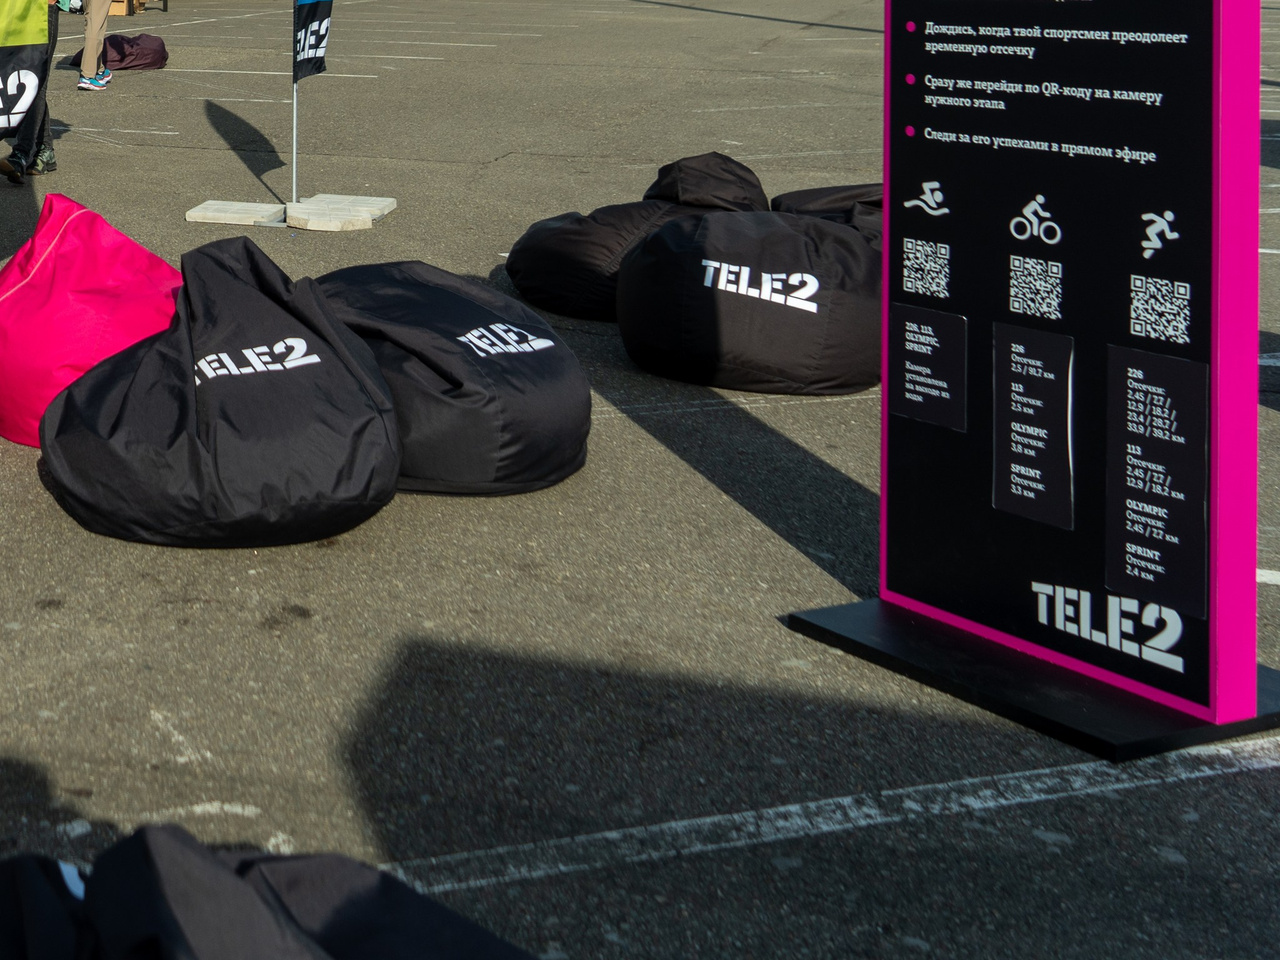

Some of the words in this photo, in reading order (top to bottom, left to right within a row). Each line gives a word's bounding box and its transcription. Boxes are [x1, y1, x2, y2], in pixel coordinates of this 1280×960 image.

[925, 22, 976, 37] Дождись,
[979, 26, 1011, 38] когда
[1013, 26, 1041, 37] твой
[1043, 28, 1109, 41] спортсмен
[1112, 31, 1188, 45] преодолеет
[925, 42, 988, 56] временную
[990, 45, 1035, 59] отсечку
[925, 75, 954, 90] Сразу
[956, 79, 972, 89] же
[974, 79, 1023, 93] перейди
[1025, 84, 1039, 93] по
[1041, 82, 1092, 100] QR-коду
[1094, 88, 1111, 98] на
[1113, 90, 1163, 106] камеру
[925, 94, 971, 107] нужного
[973, 99, 1005, 110] этапа
[924, 128, 956, 141] Следи
[959, 133, 970, 143] за
[972, 135, 990, 145] его
[992, 136, 1049, 151] успехами
[1051, 143, 1059, 152] в
[1061, 143, 1112, 158] прямом
[1115, 147, 1156, 164] эфире
[701, 259, 819, 314] TELE2
[1127, 367, 1144, 379] 226
[1010, 422, 1048, 439] OLYMPIC
[1126, 443, 1142, 455] 113
[1010, 463, 1042, 479] SPRINT
[1126, 498, 1168, 518] OLYMPIC
[1126, 542, 1161, 561] SPRINT
[1031, 581, 1185, 674] TELE2
